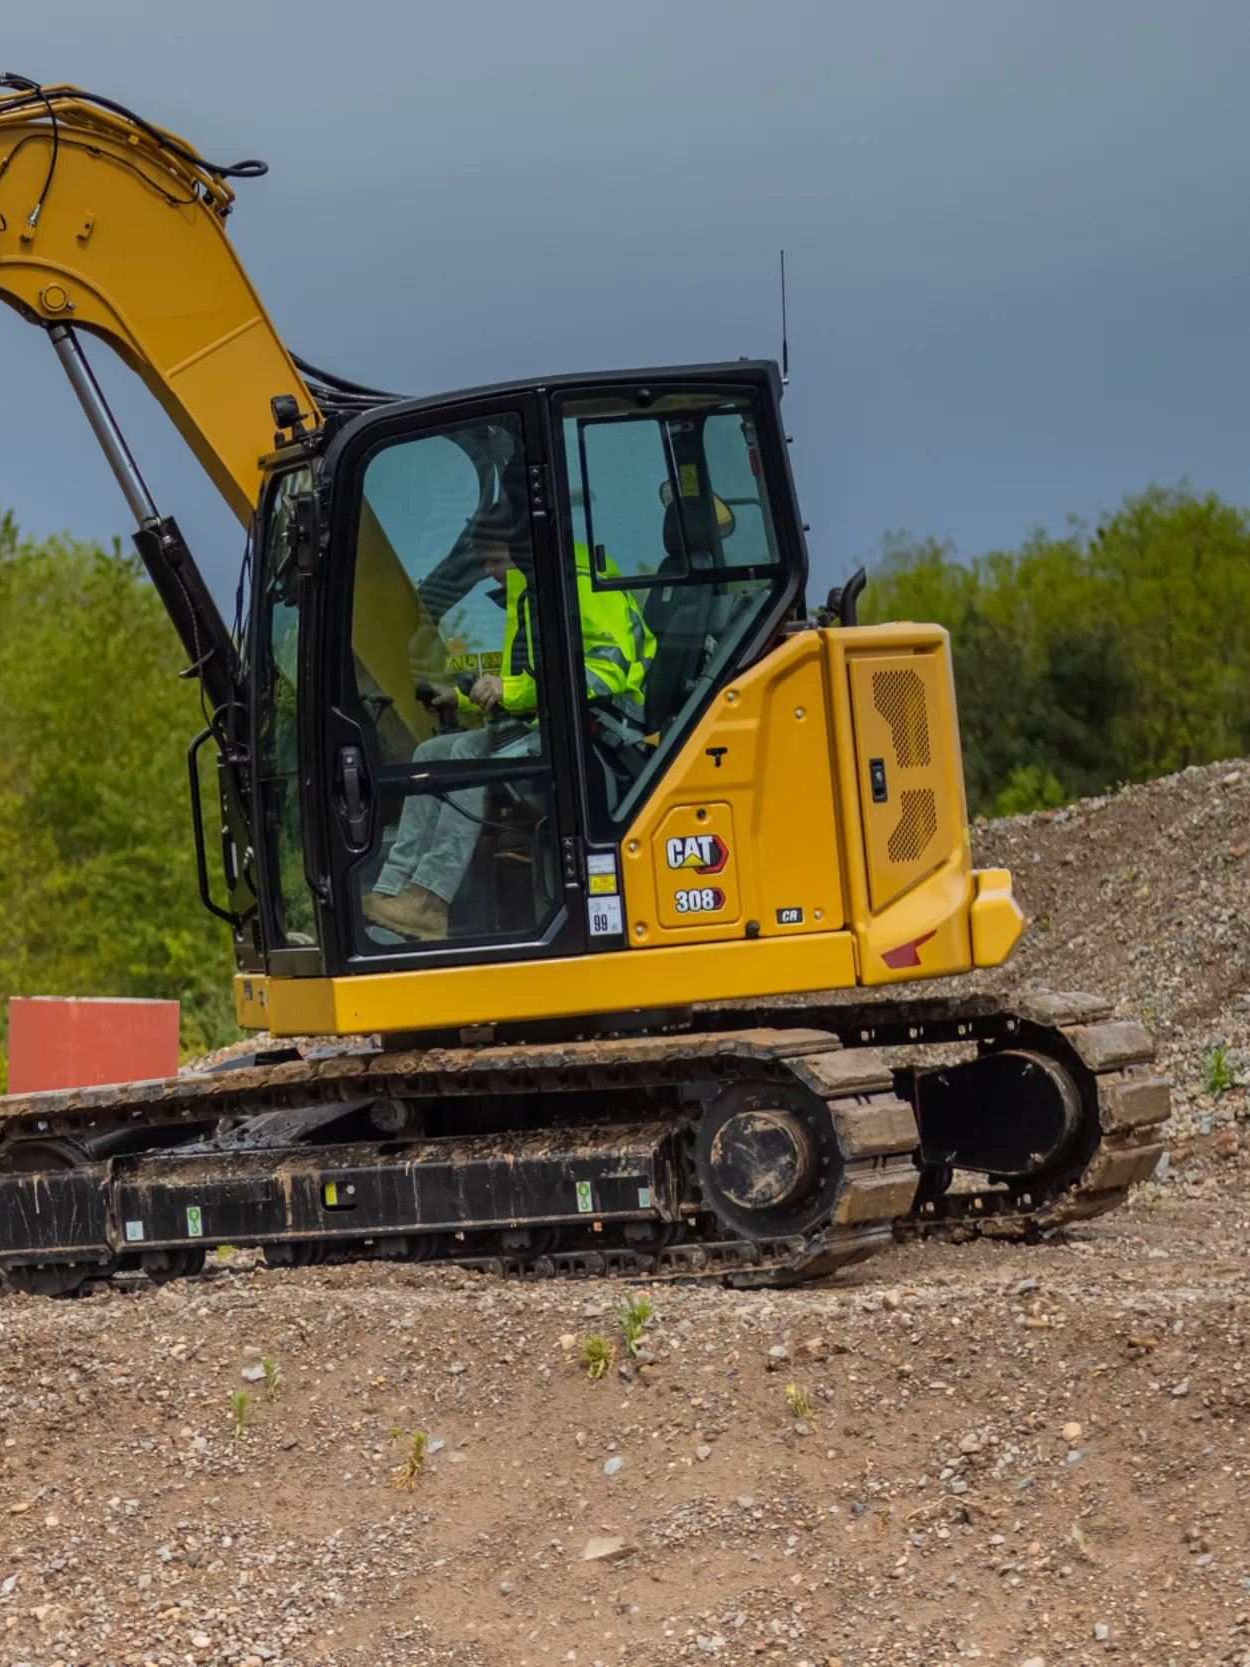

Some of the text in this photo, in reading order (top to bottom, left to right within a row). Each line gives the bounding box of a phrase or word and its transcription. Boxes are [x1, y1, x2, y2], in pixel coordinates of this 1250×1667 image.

[667, 836, 714, 869] CAT
[675, 888, 715, 913] 308
[594, 914, 608, 932] 99
[782, 910, 798, 922] CR
